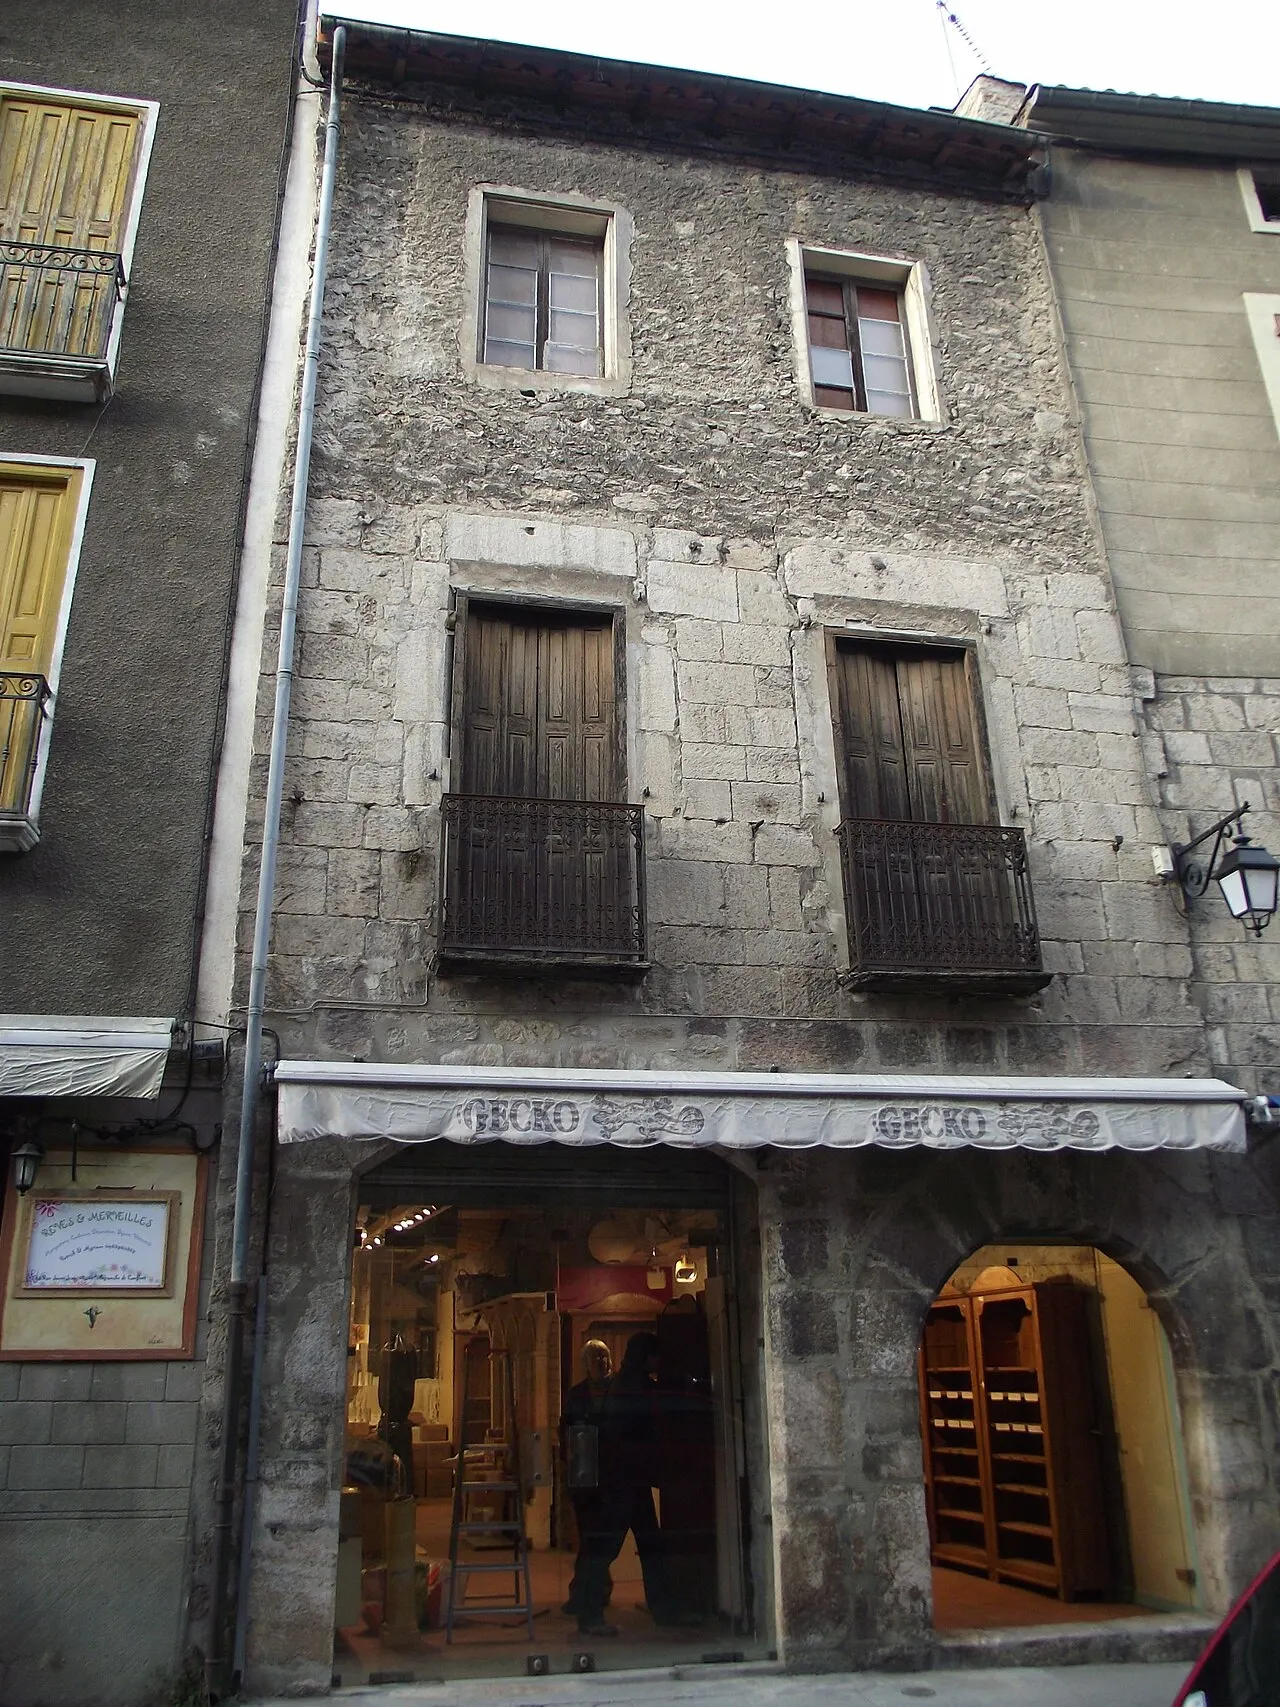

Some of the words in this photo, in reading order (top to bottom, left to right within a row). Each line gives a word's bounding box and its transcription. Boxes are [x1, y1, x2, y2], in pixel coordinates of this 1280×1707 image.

[457, 1098, 580, 1133] GECKO
[873, 1106, 986, 1140] GECKO
[76, 1213, 85, 1224] &
[88, 1211, 154, 1228] MERVEILLES
